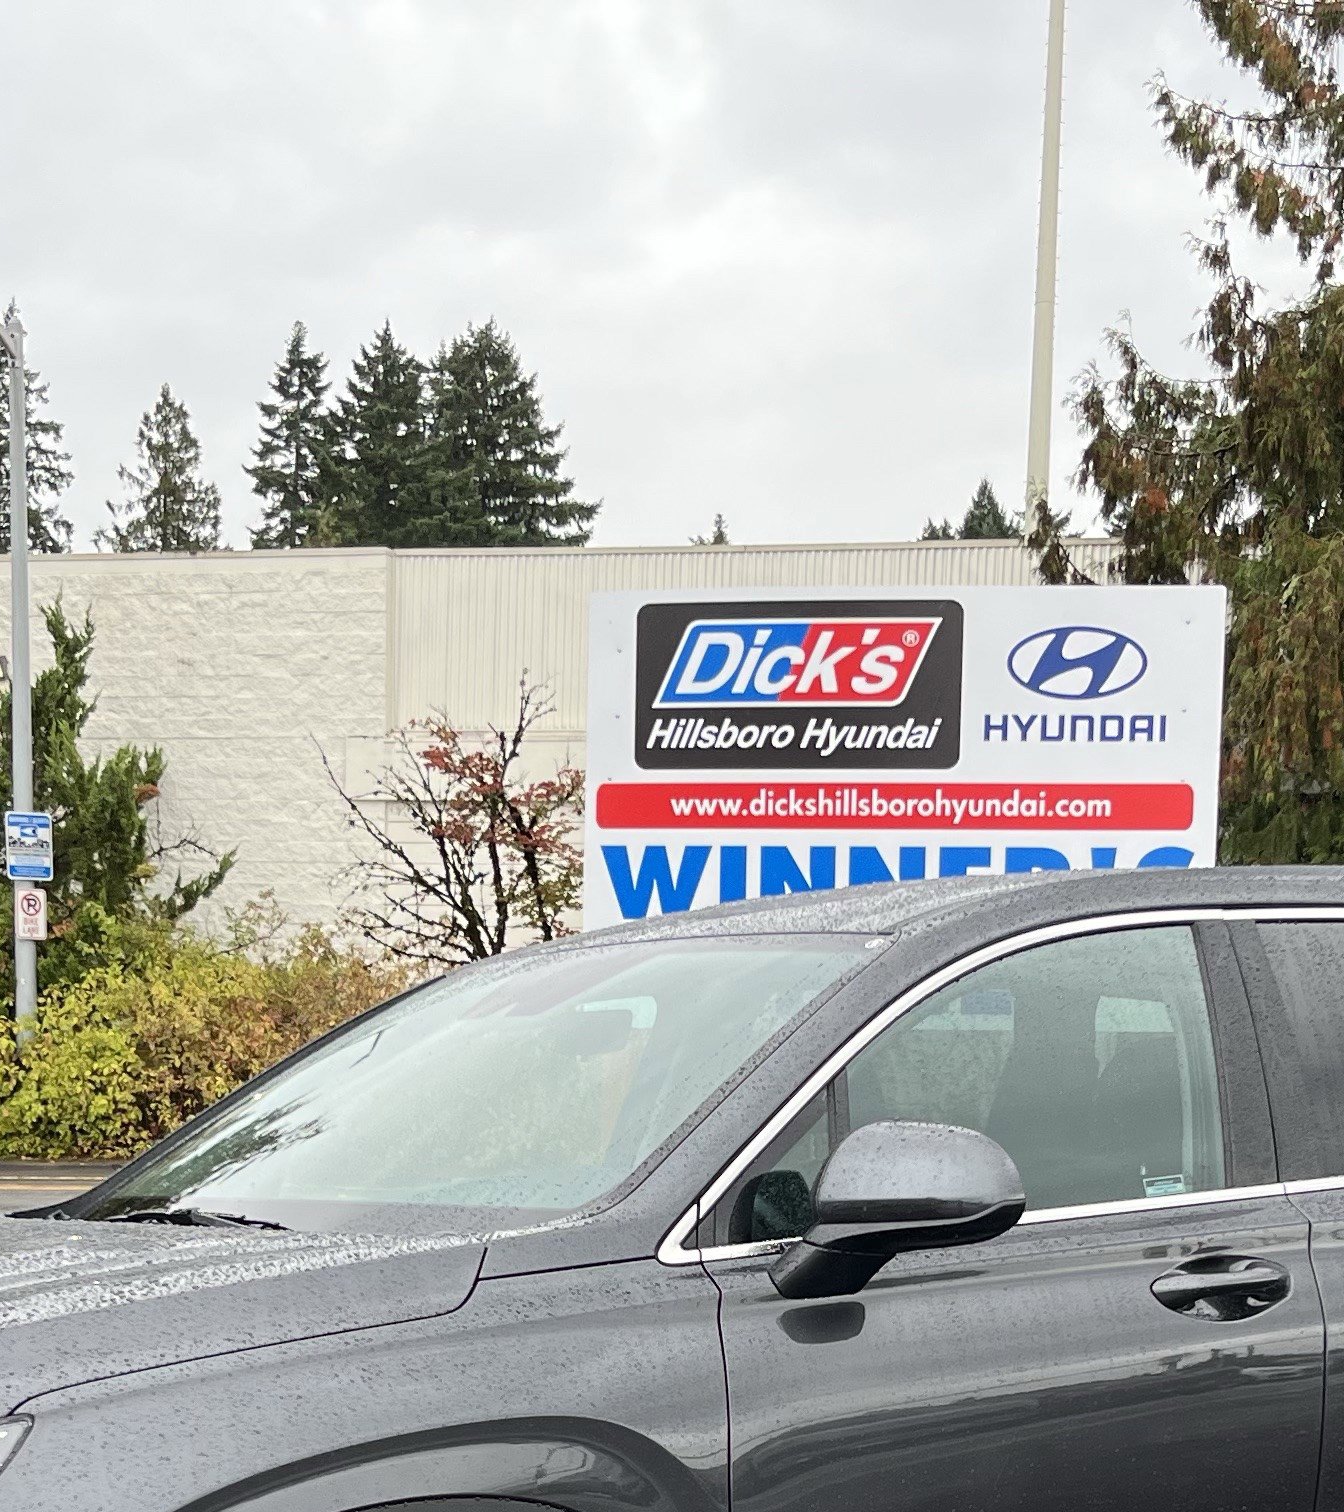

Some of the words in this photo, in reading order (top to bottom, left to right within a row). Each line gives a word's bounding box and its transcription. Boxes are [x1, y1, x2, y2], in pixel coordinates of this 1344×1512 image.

[674, 627, 903, 697] Dick's
[646, 717, 795, 750] Hillsboro
[799, 717, 943, 757] Hyundai
[983, 714, 1167, 743] HYUNDAI
[670, 788, 1112, 823] www.dickshillsborohyundai.com
